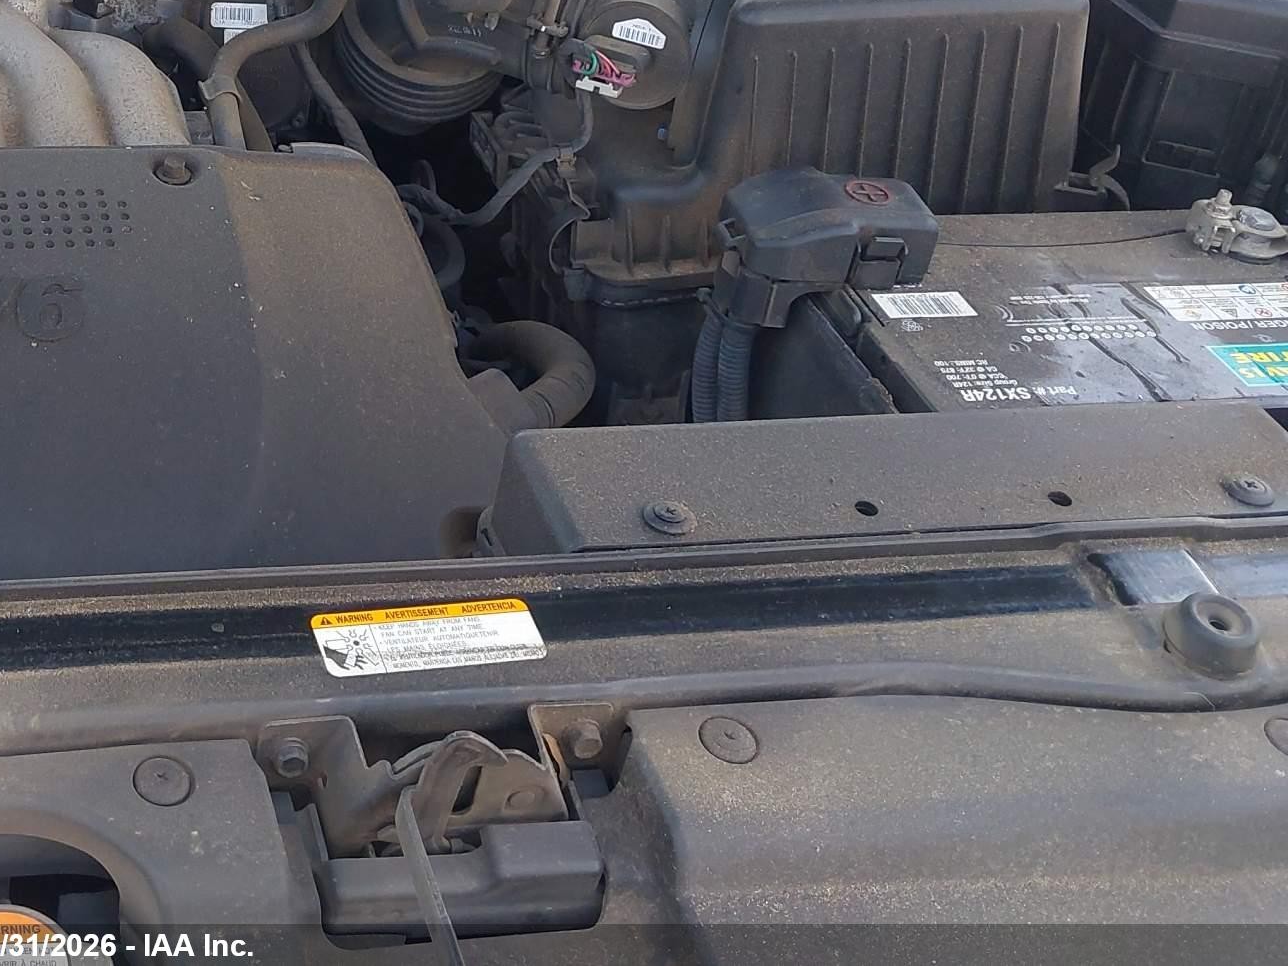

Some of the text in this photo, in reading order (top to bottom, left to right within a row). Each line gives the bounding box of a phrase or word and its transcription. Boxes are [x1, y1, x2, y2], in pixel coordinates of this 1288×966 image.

[959, 386, 1032, 402] SX124R
[1048, 386, 1077, 395] Part
[335, 602, 517, 624] WARNING AVERTISSEMENT ADVERTENCIA
